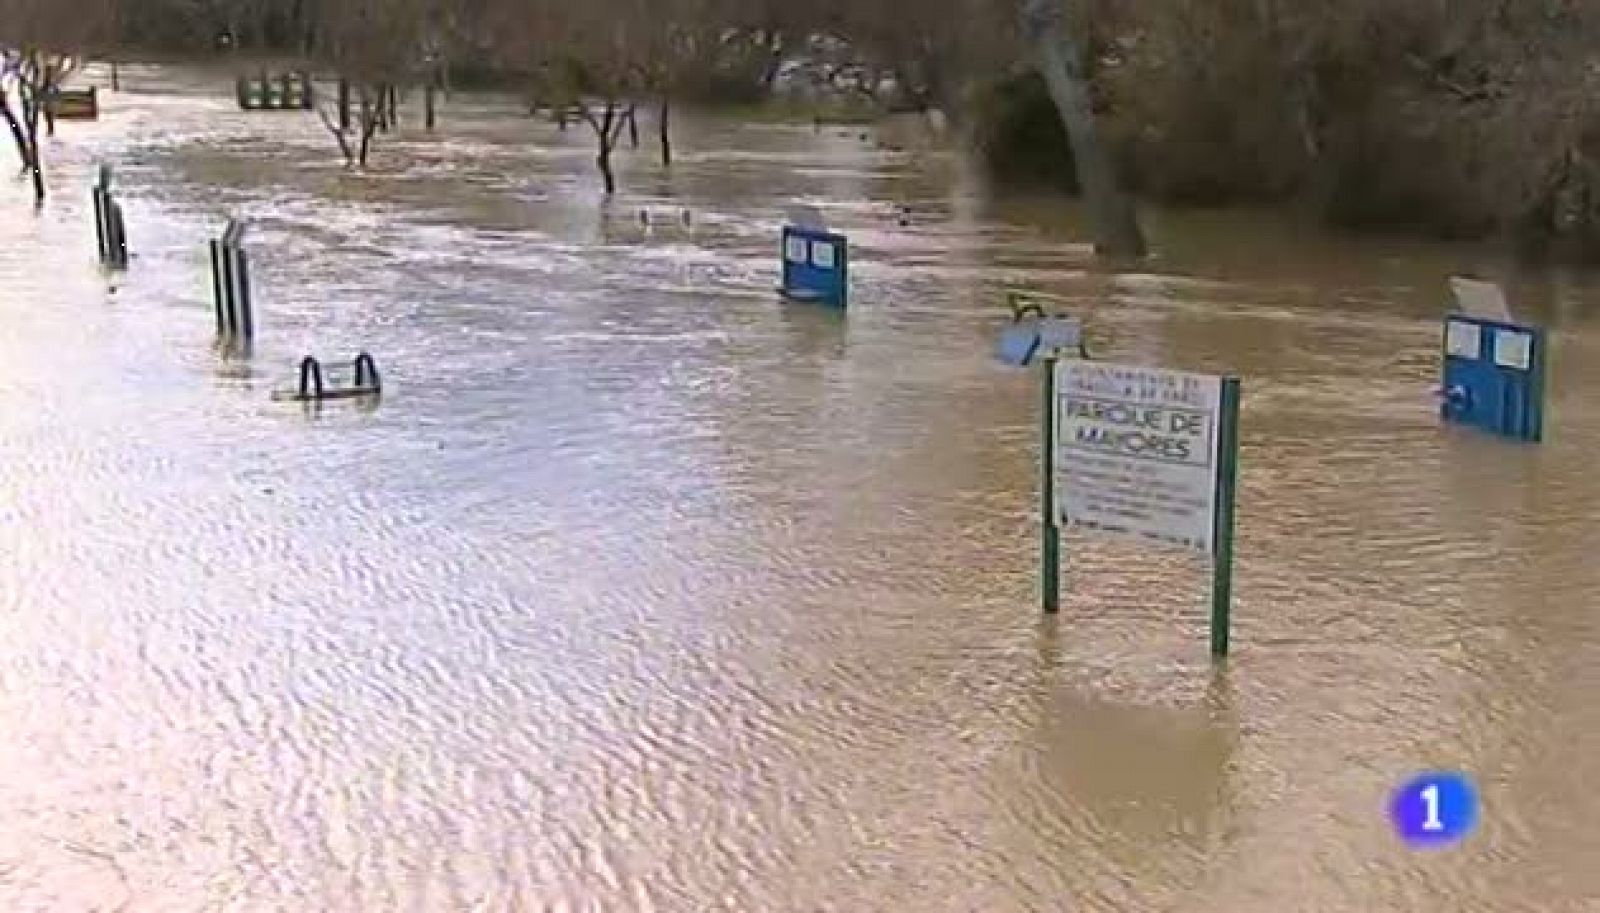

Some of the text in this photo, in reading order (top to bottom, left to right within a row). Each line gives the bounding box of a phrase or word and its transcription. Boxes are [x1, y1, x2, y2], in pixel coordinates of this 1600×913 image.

[1067, 400, 1202, 436] PARQUE DE
[1077, 426, 1190, 457] MAYORES
